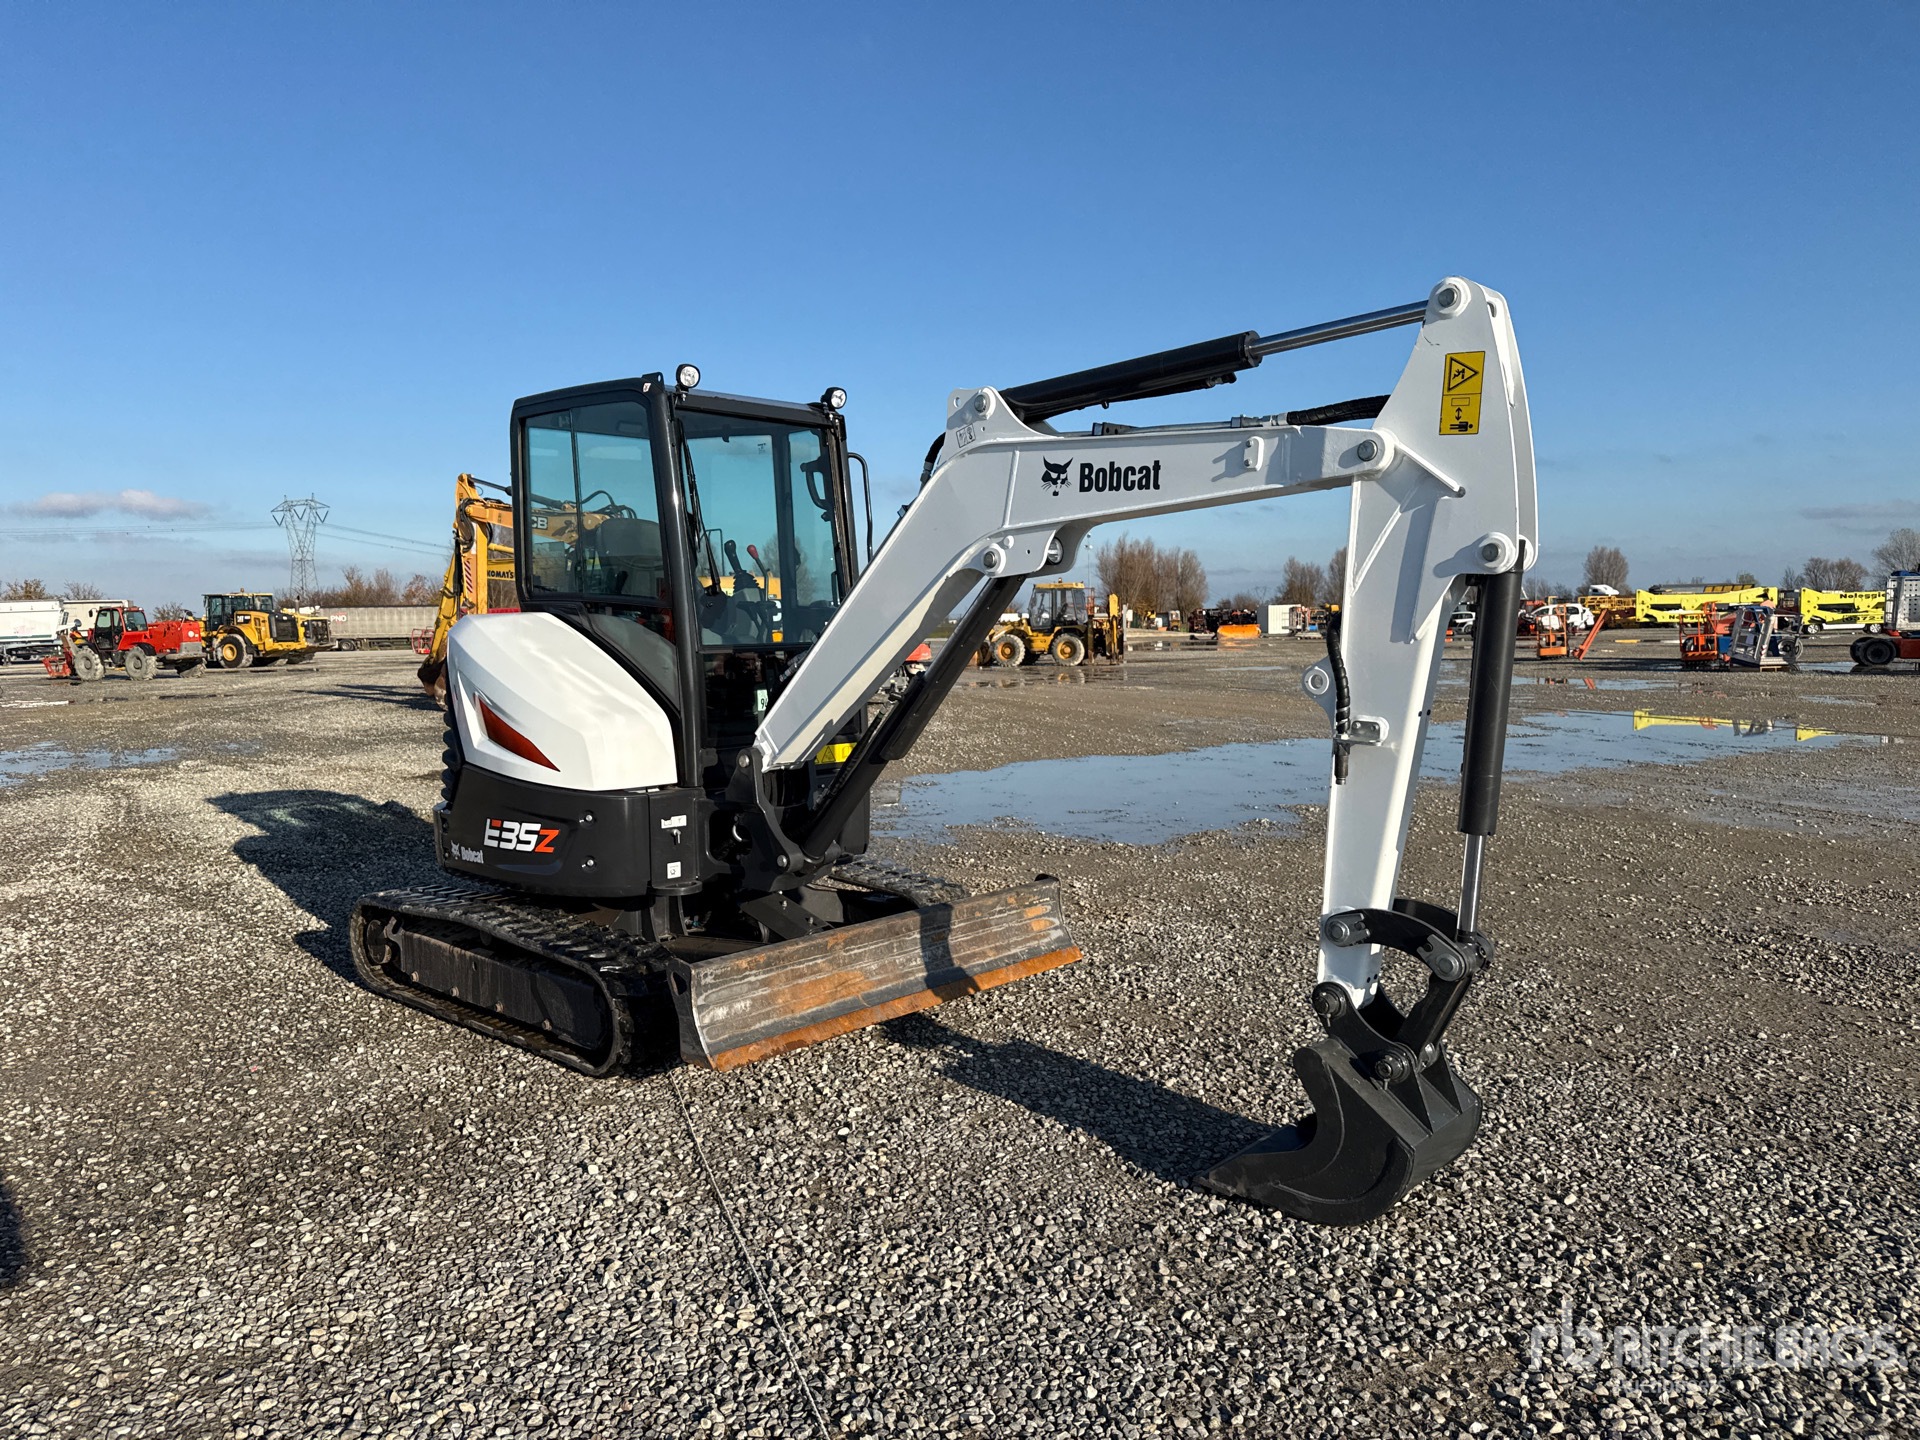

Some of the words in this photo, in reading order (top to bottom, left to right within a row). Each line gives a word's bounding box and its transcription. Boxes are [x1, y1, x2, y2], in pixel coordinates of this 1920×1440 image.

[1079, 460, 1161, 493] Bobcat
[530, 516, 548, 530] CB
[487, 569, 515, 579] KOMATS
[460, 846, 485, 864] Bobcat
